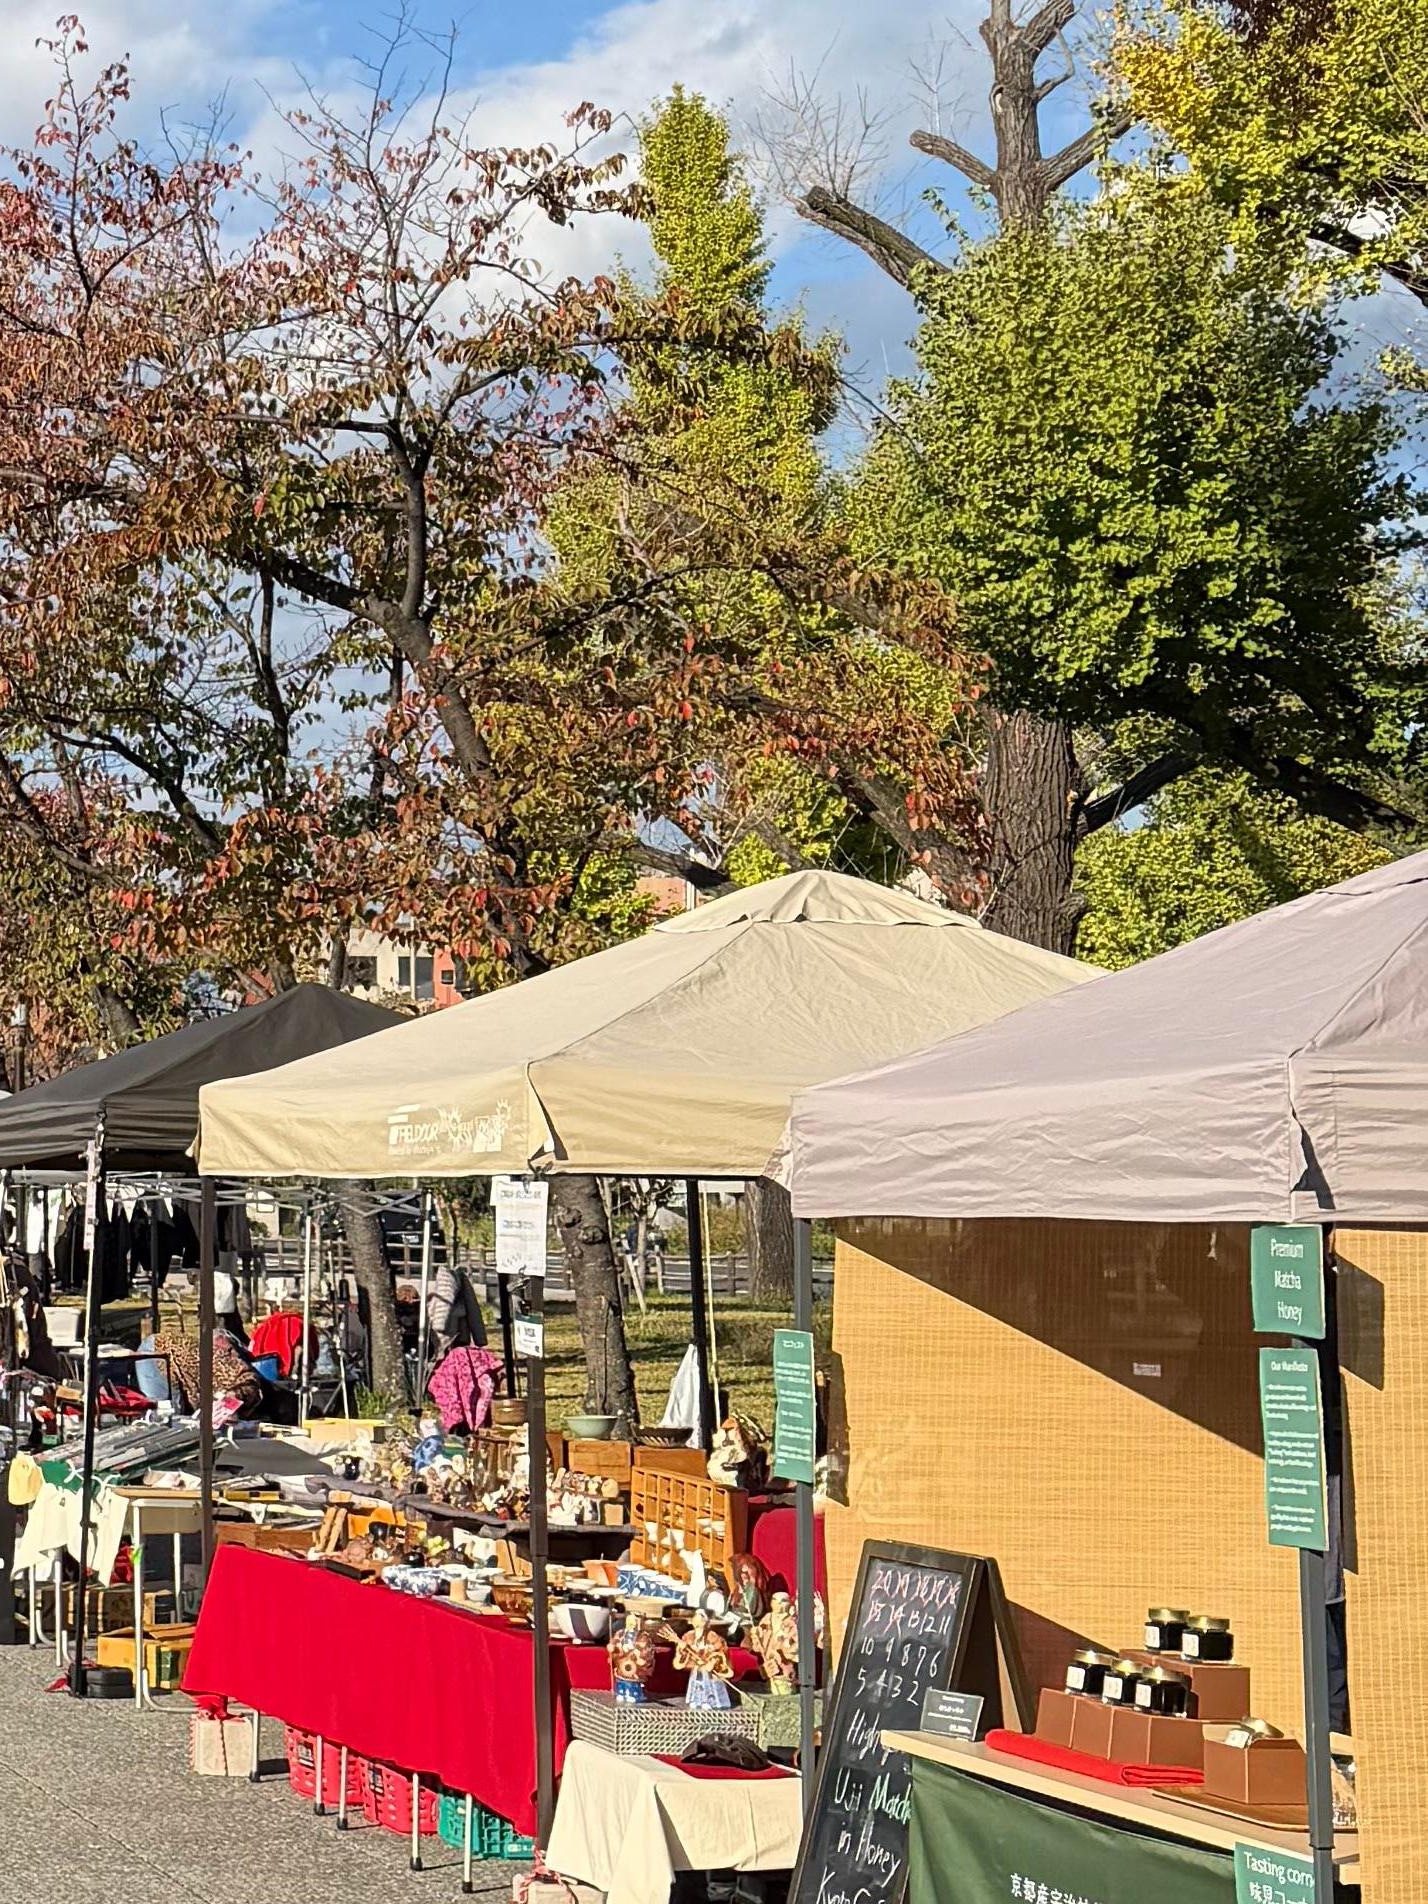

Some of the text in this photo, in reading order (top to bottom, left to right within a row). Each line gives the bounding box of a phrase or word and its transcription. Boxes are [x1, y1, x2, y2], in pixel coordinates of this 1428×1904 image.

[1270, 1238, 1304, 1258] Premium
[1274, 1270, 1302, 1290] Matcha
[1277, 1301, 1303, 1326] Honey
[919, 1613, 937, 1635] 12
[938, 1615, 951, 1635] 11
[860, 1636, 875, 1655] 10
[885, 1637, 895, 1662] 9
[901, 1643, 912, 1667] 8
[929, 1650, 942, 1678] 6
[855, 1667, 867, 1697] 5
[891, 1675, 903, 1698] 3
[906, 1680, 919, 1706] 2
[838, 1820, 902, 1888] in Honey
[1244, 1851, 1286, 1885] Tasting
